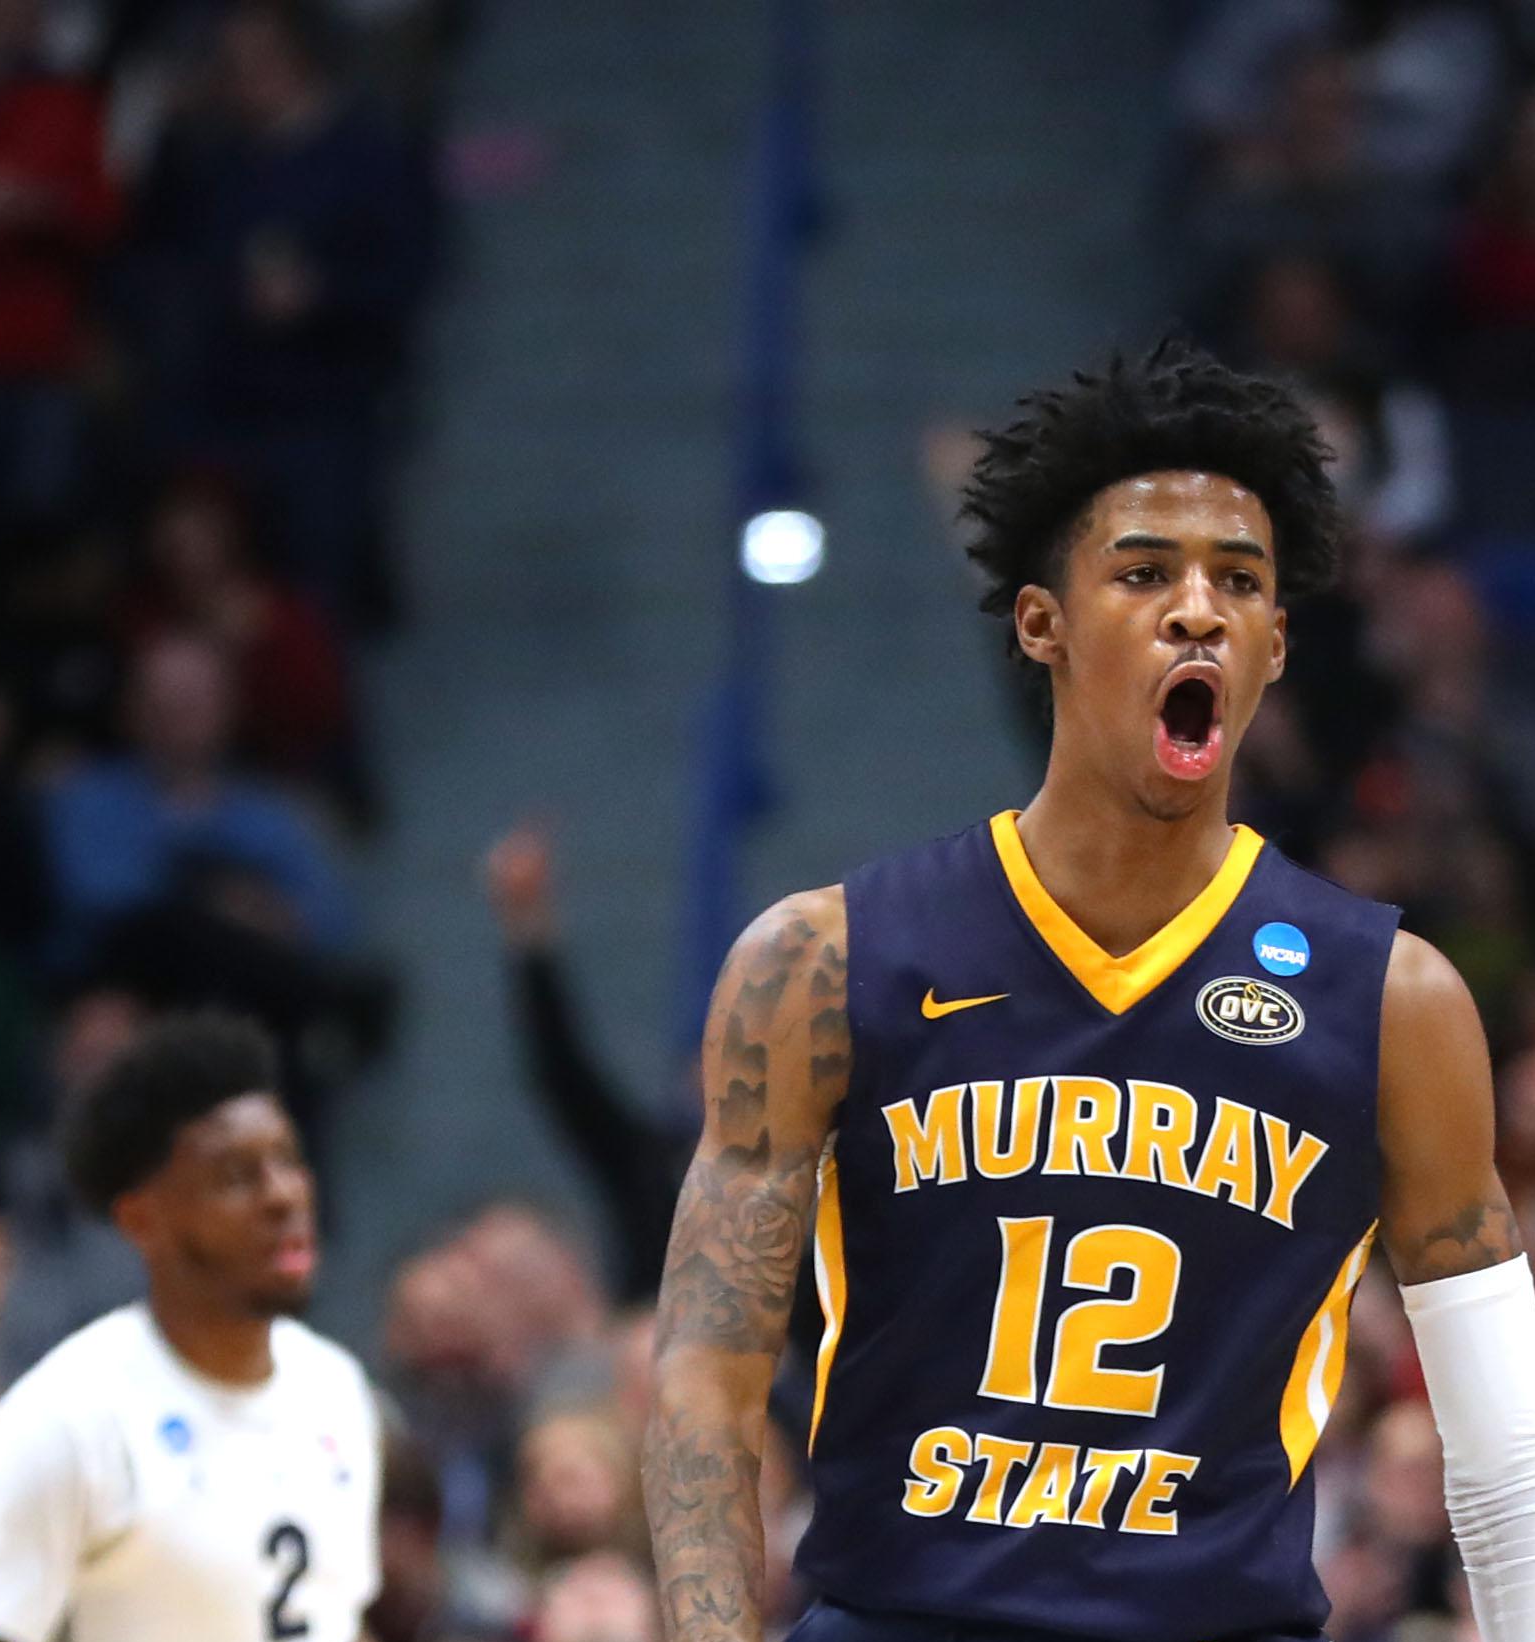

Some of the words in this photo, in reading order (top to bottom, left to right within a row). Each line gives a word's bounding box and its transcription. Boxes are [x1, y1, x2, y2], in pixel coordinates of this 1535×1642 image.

[1219, 994, 1281, 1027] OVC
[1260, 944, 1306, 967] NCAA
[881, 1075, 1330, 1230] MURRAY
[977, 1215, 1182, 1418] 12
[901, 1426, 1201, 1535] STATE
[264, 1516, 311, 1642] 2
